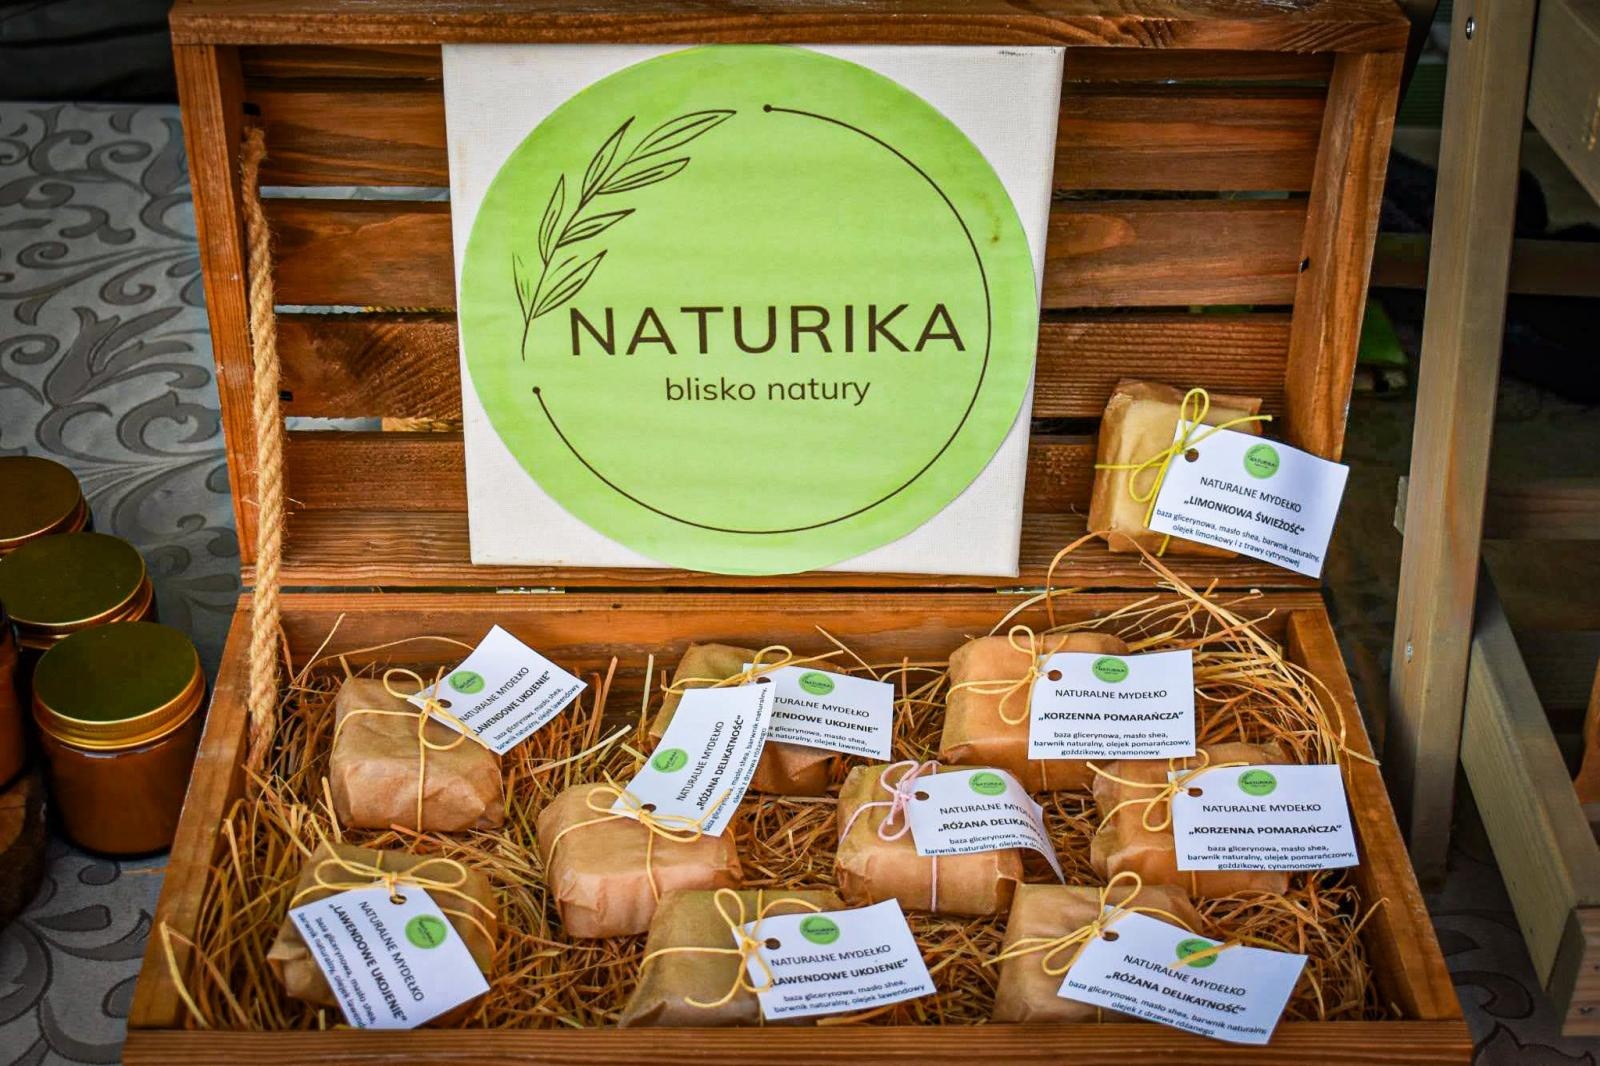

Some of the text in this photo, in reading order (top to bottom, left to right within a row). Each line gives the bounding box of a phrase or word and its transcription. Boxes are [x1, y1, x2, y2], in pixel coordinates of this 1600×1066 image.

[569, 303, 967, 356] NATURIKA
[665, 377, 871, 406] blisko natury
[1200, 476, 1302, 513] NATURALNE MYDEŁKO
[1156, 508, 1172, 519] baza
[1173, 511, 1218, 531] glicerynowa,
[1219, 524, 1240, 536] masło
[1242, 529, 1261, 542] shea,
[1262, 535, 1287, 549] barwnik
[1172, 524, 1193, 538] olejek
[1194, 528, 1233, 547] limonkowy
[1244, 542, 1265, 555] trawy
[458, 693, 500, 723] NATURALNE
[499, 667, 530, 696] MYDEŁKO
[1055, 689, 1168, 700] NATURALNE MYDEŁKO
[774, 696, 870, 718] TURALNE MYDEŁKO
[1053, 731, 1072, 739] baza
[1073, 731, 1121, 740] glicerynowa,
[1148, 731, 1168, 739] shea,
[1066, 740, 1104, 748] naturalny,
[1106, 739, 1130, 748] olejek
[1131, 739, 1191, 748] pomarańczowy,
[677, 721, 725, 802] NATURALNE MYDEŁKO
[939, 803, 1002, 816] NATURALNE
[1202, 803, 1322, 813] NATURALNE MYDEŁKO
[969, 833, 1018, 843] glicerynowa,
[1228, 845, 1279, 853] glicerynowa,
[1187, 852, 1354, 862] barwnik naturalny, olejek pomarańczowy,
[358, 901, 425, 1002] NATURALNE MYDEŁKO
[771, 944, 891, 967] NATURALNE MYDEŁKO
[1123, 954, 1190, 983] NATURALNE
[1191, 975, 1247, 997] MYDEŁKO
[1068, 980, 1087, 990] baza
[1087, 985, 1138, 1004] glicerynowa,
[1141, 999, 1166, 1011] masło
[1191, 1014, 1225, 1029] barwnik
[1111, 1001, 1137, 1014] olejek
